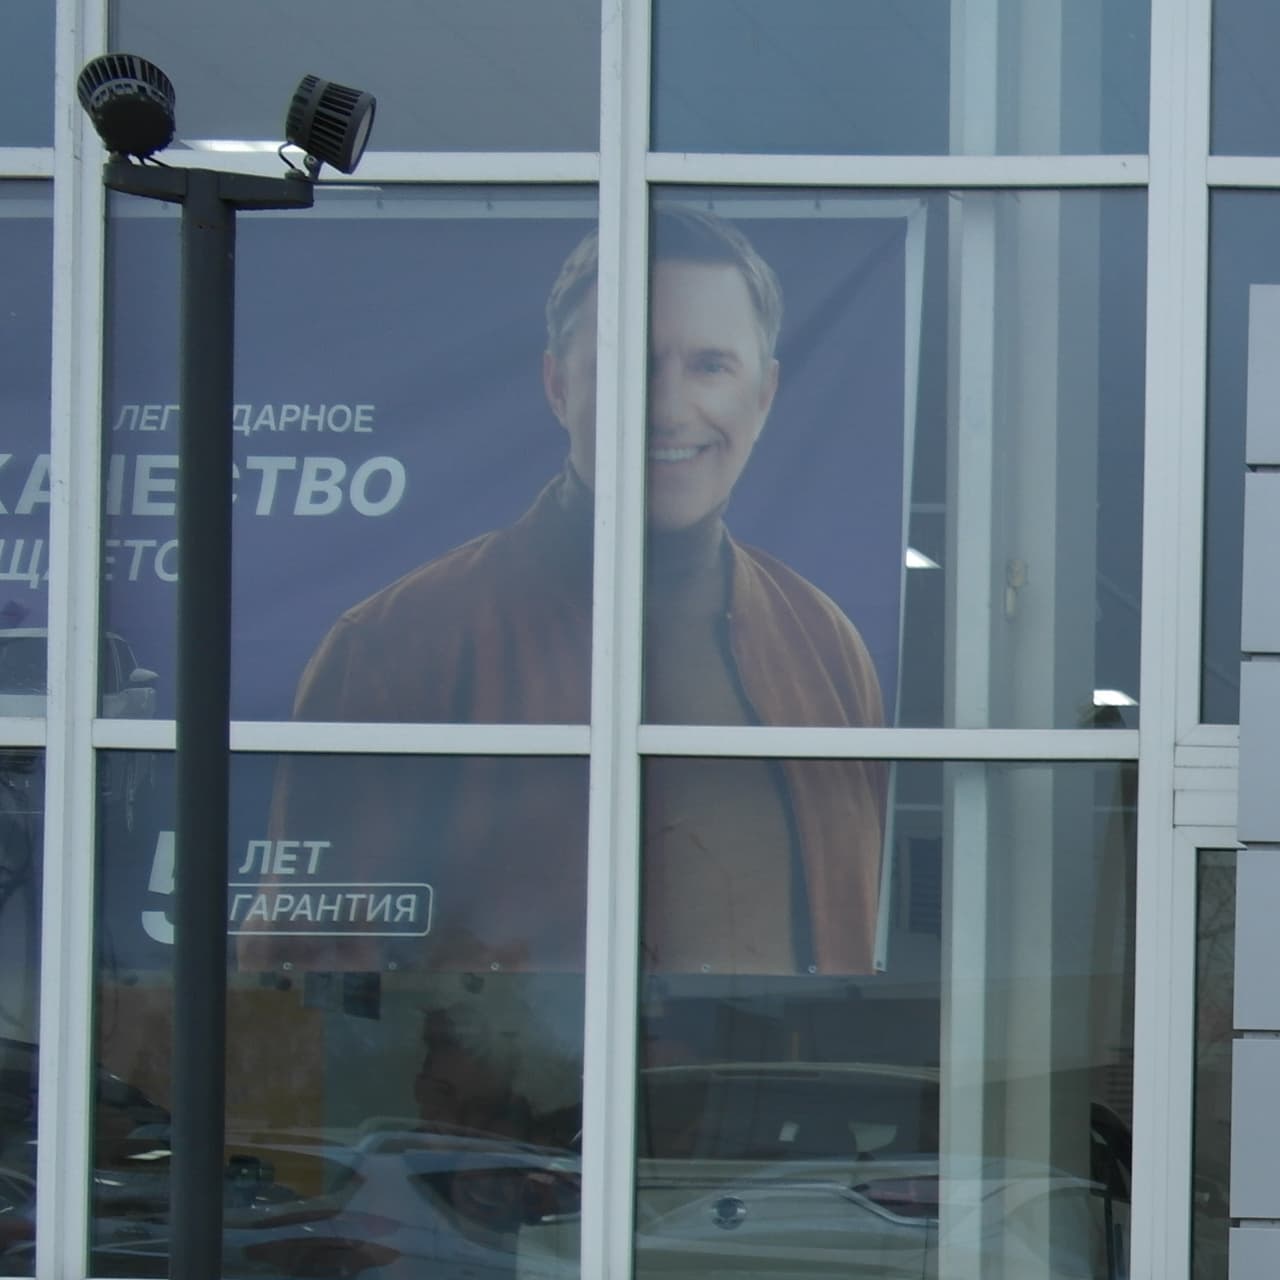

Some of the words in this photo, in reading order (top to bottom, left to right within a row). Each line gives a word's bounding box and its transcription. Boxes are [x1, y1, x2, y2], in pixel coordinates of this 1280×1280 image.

[113, 404, 375, 436] ЛЕГДАРНОЕ
[238, 840, 331, 875] ЛЕТ
[228, 893, 417, 922] ГАРАНТИЯ
